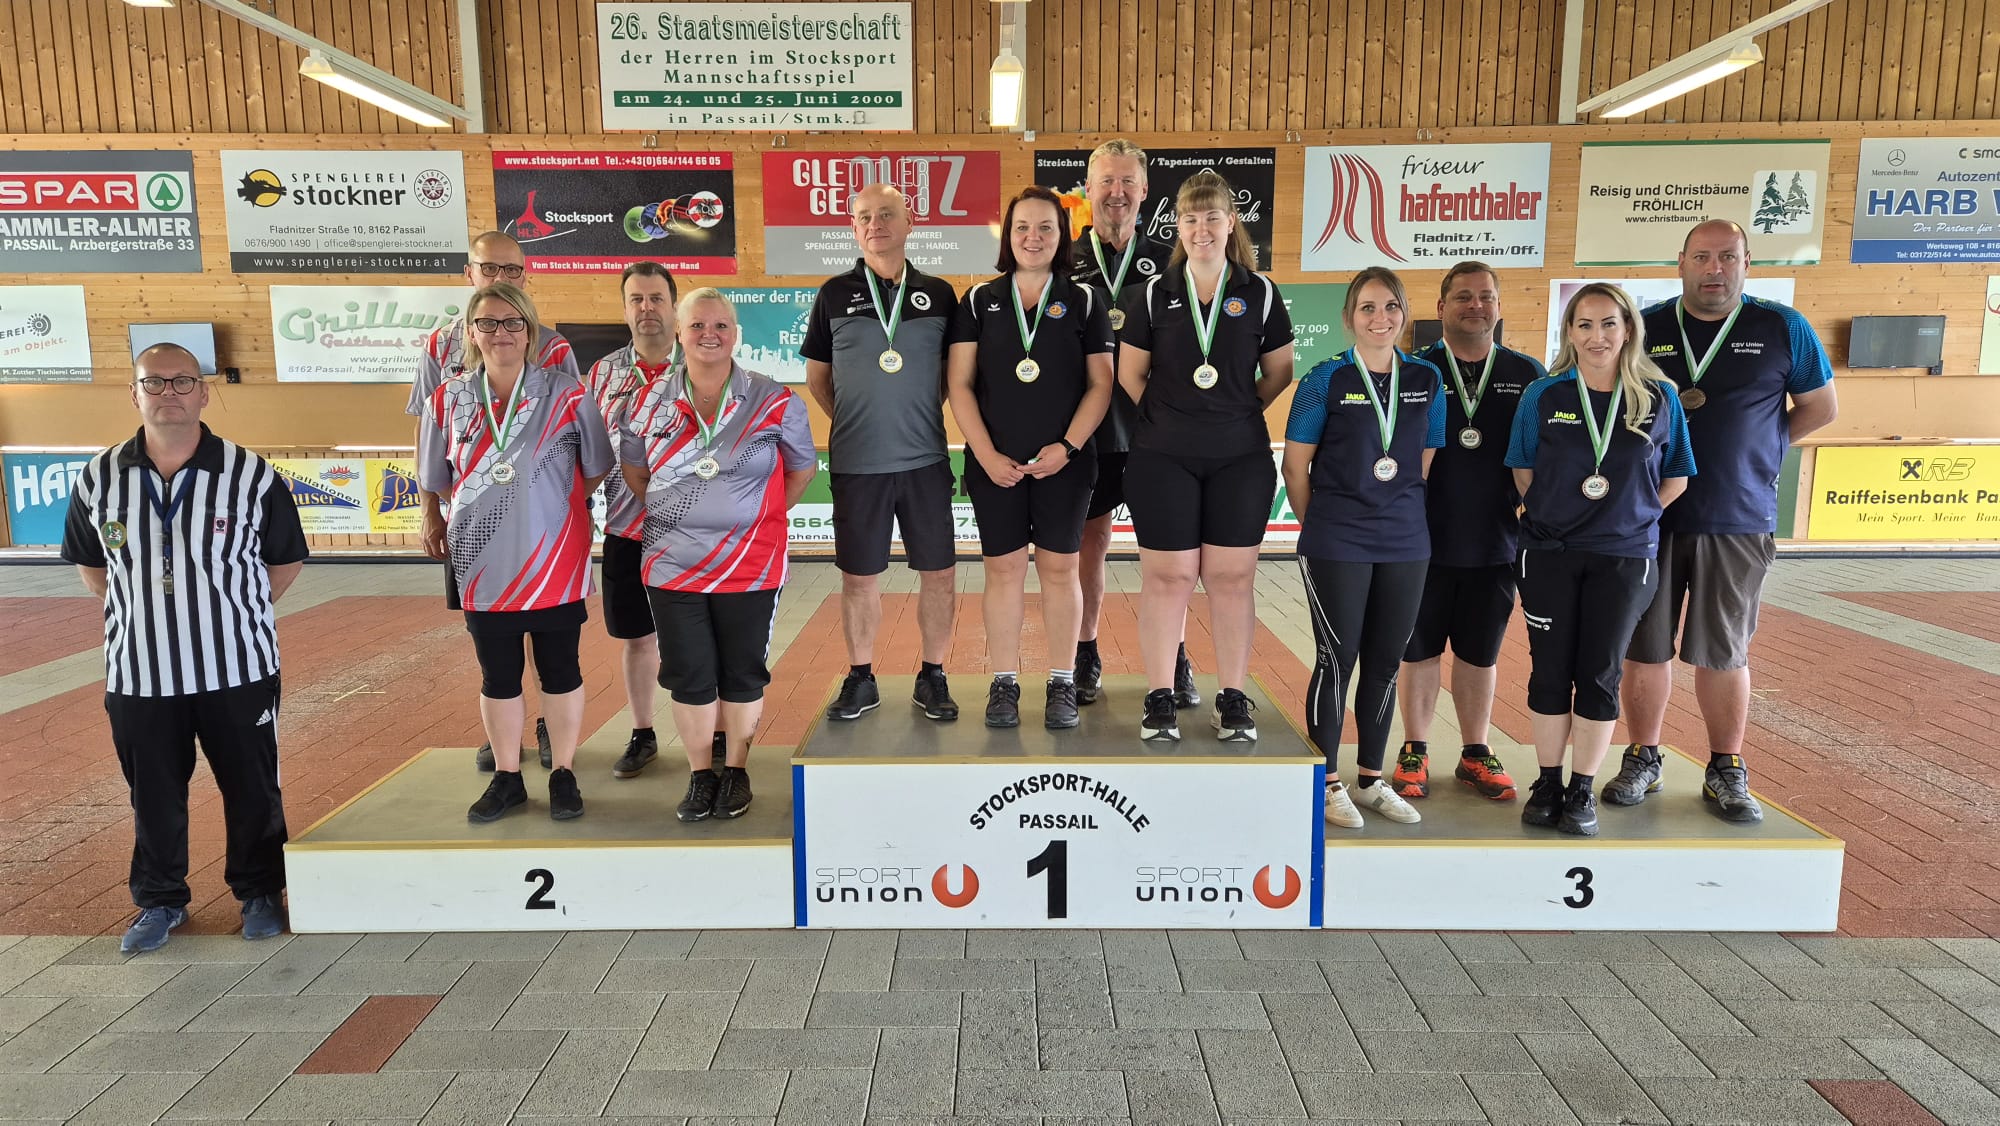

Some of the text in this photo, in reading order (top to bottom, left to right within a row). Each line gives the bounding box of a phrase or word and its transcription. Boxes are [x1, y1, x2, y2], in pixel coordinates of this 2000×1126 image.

[611, 12, 901, 40] 26. Staatsmeisterschaft
[621, 50, 897, 67] der Herren im Stocksport
[663, 69, 856, 86] Mannschaftsspiel
[621, 92, 894, 106] am 24. und 25. Juni 2000
[668, 112, 849, 125] in Passail/Stmk.
[504, 156, 600, 167] www.stocksport.net
[695, 157, 707, 166] 66
[708, 157, 721, 166] 05
[1037, 157, 1273, 167] Streichen Tapezieren Gestalten
[1401, 155, 1485, 179] friseur
[291, 173, 406, 183] SPENGLEREI
[0, 180, 135, 205] SPAR
[292, 185, 406, 206] stockner
[1590, 183, 1750, 199] Reisig und Christbäume
[1399, 181, 1542, 222] hafenthaler
[1632, 199, 1704, 212] FRÖHLICH
[1866, 188, 1979, 217] HARB
[544, 211, 614, 225] Stocksport
[269, 225, 426, 235] Fladnitzer Straße 10, 8162 Passail
[516, 227, 540, 237] HLS
[1913, 222, 1993, 235] Der Partner für
[4, 239, 195, 253] PASSAIL, Arzbergerstraße 33
[244, 239, 453, 250] 0676/900 1490 office@spenglerei-stockner.at
[804, 242, 852, 250] SPENGLEREI
[926, 242, 960, 250] HANDEL
[1413, 245, 1539, 257] St. Kathrein/Off.
[1926, 243, 1964, 251] Werksweg
[253, 256, 448, 269] www.spenglerei-stockner.at
[532, 262, 548, 270] Vom
[549, 261, 571, 270] Stock
[573, 261, 585, 270] bis
[586, 262, 601, 270] zum
[602, 261, 622, 270] Stein
[680, 261, 700, 270] Hand
[769, 290, 791, 304] der
[1308, 324, 1329, 334] 009
[3, 337, 67, 356] am Objekt.
[319, 333, 405, 350] Gasthaus
[1651, 345, 1674, 353] JAKO
[288, 365, 313, 373] 8162
[315, 365, 355, 374] Passail,
[1554, 411, 1576, 420] JAKO
[272, 463, 361, 505] Installationen
[1826, 489, 2000, 505] Raiffeisenbank Pa
[1856, 512, 2000, 525] Mein Sport. Meine Ban
[969, 772, 1151, 833] STOCKSPORT-HALLE
[1018, 813, 1099, 830] PASSAIL
[815, 867, 923, 884] SPORT
[1026, 839, 1068, 919] 1
[1136, 866, 1243, 884] SPORT
[524, 868, 556, 910] 2
[1562, 866, 1594, 909] 3
